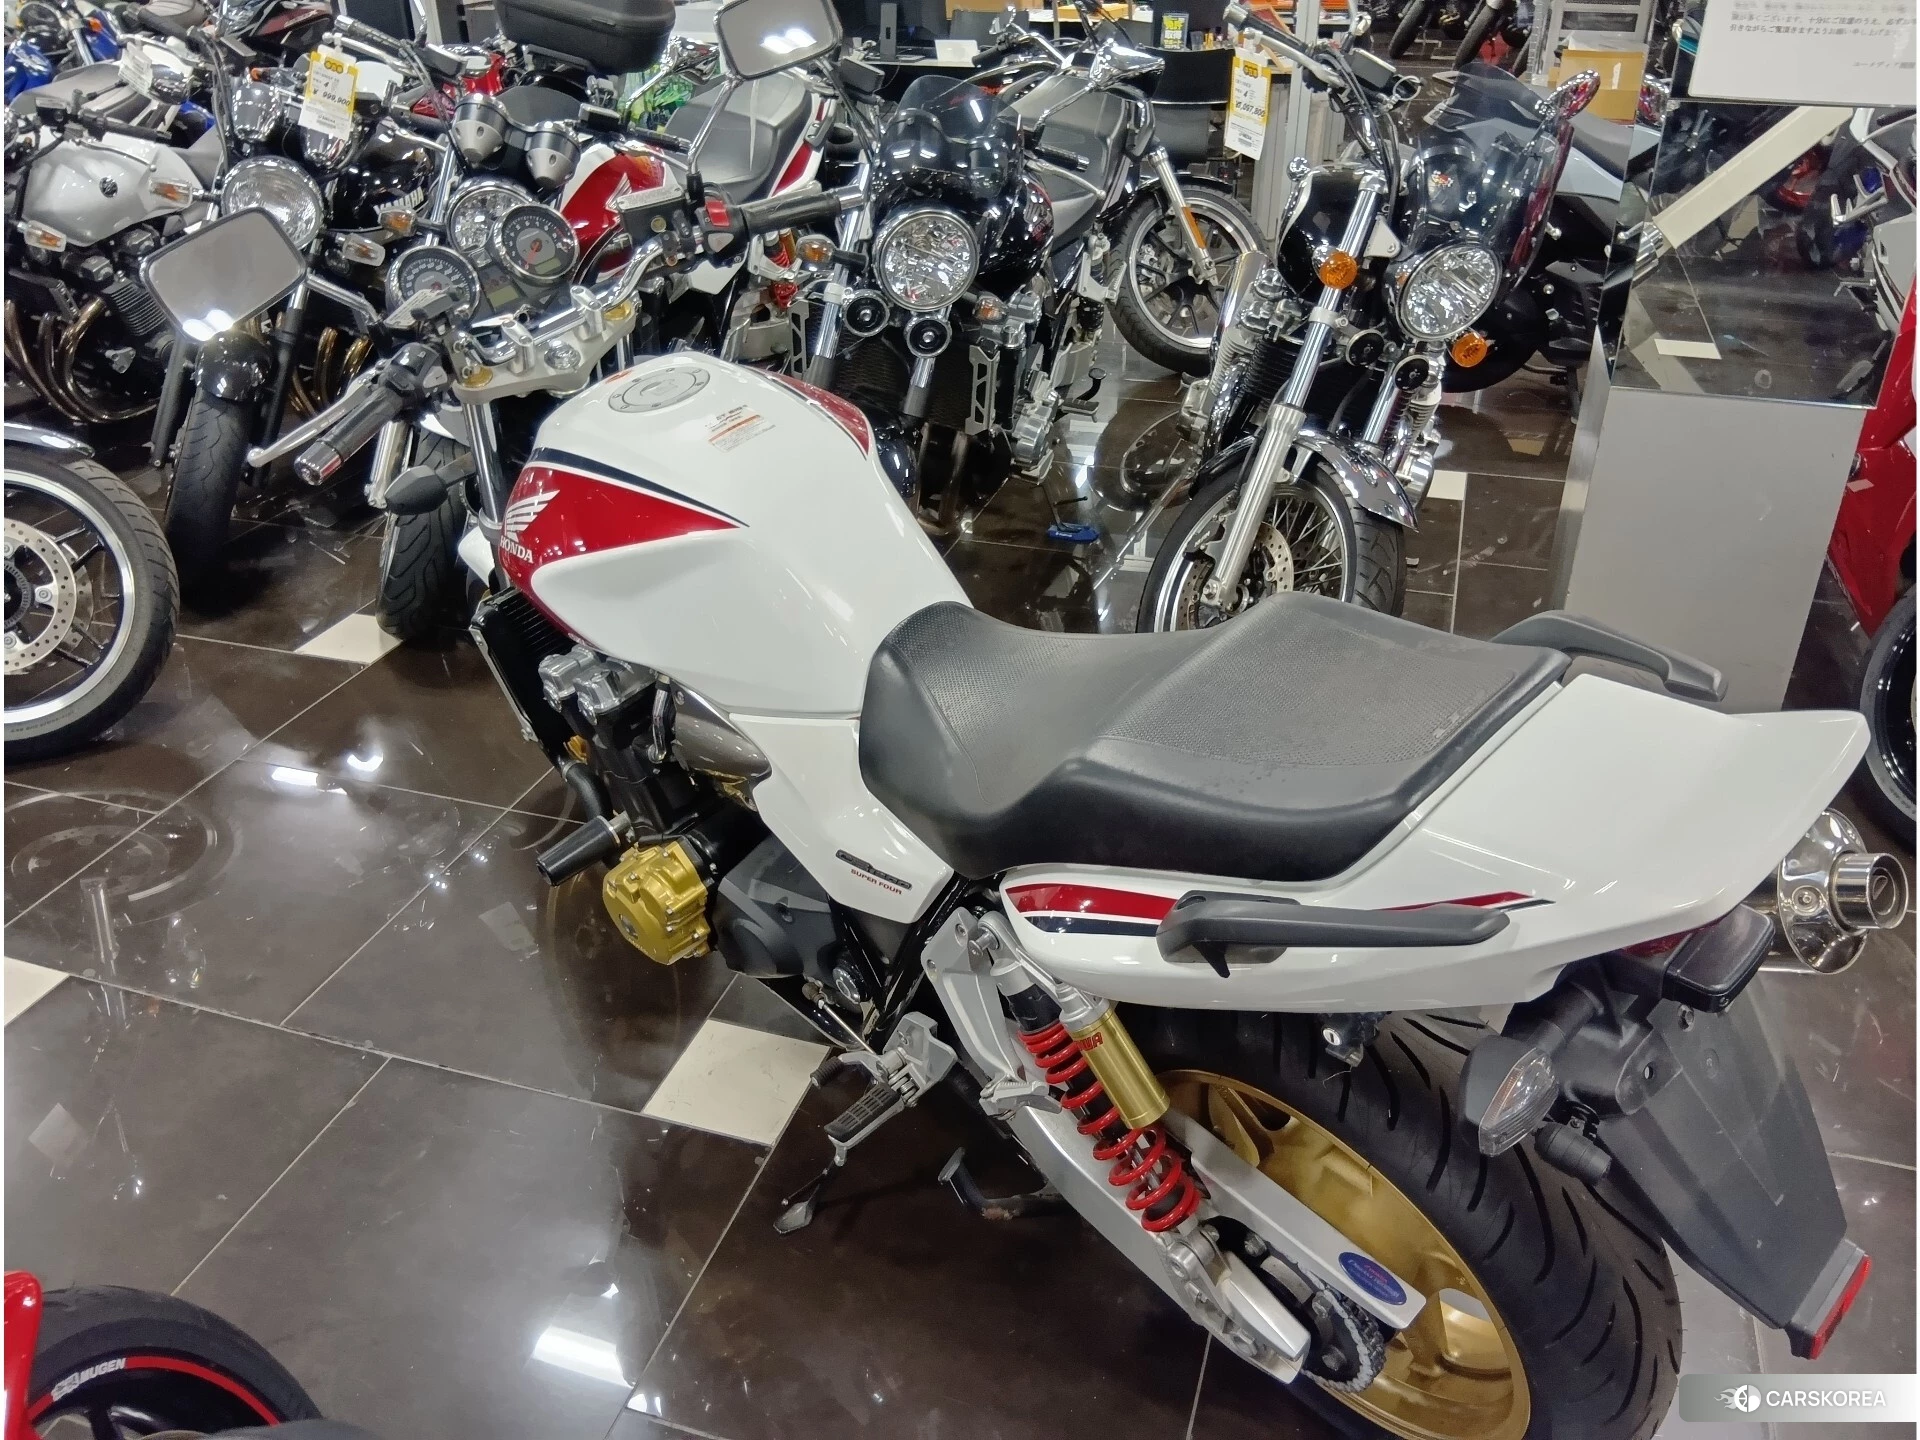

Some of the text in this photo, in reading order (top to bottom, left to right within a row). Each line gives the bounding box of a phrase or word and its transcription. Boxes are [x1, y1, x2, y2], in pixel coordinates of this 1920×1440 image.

[322, 91, 351, 107] 999,900
[500, 535, 534, 564] HONDA
[850, 868, 903, 895] SUPER FOUR
[80, 1357, 127, 1385] MUGEN
